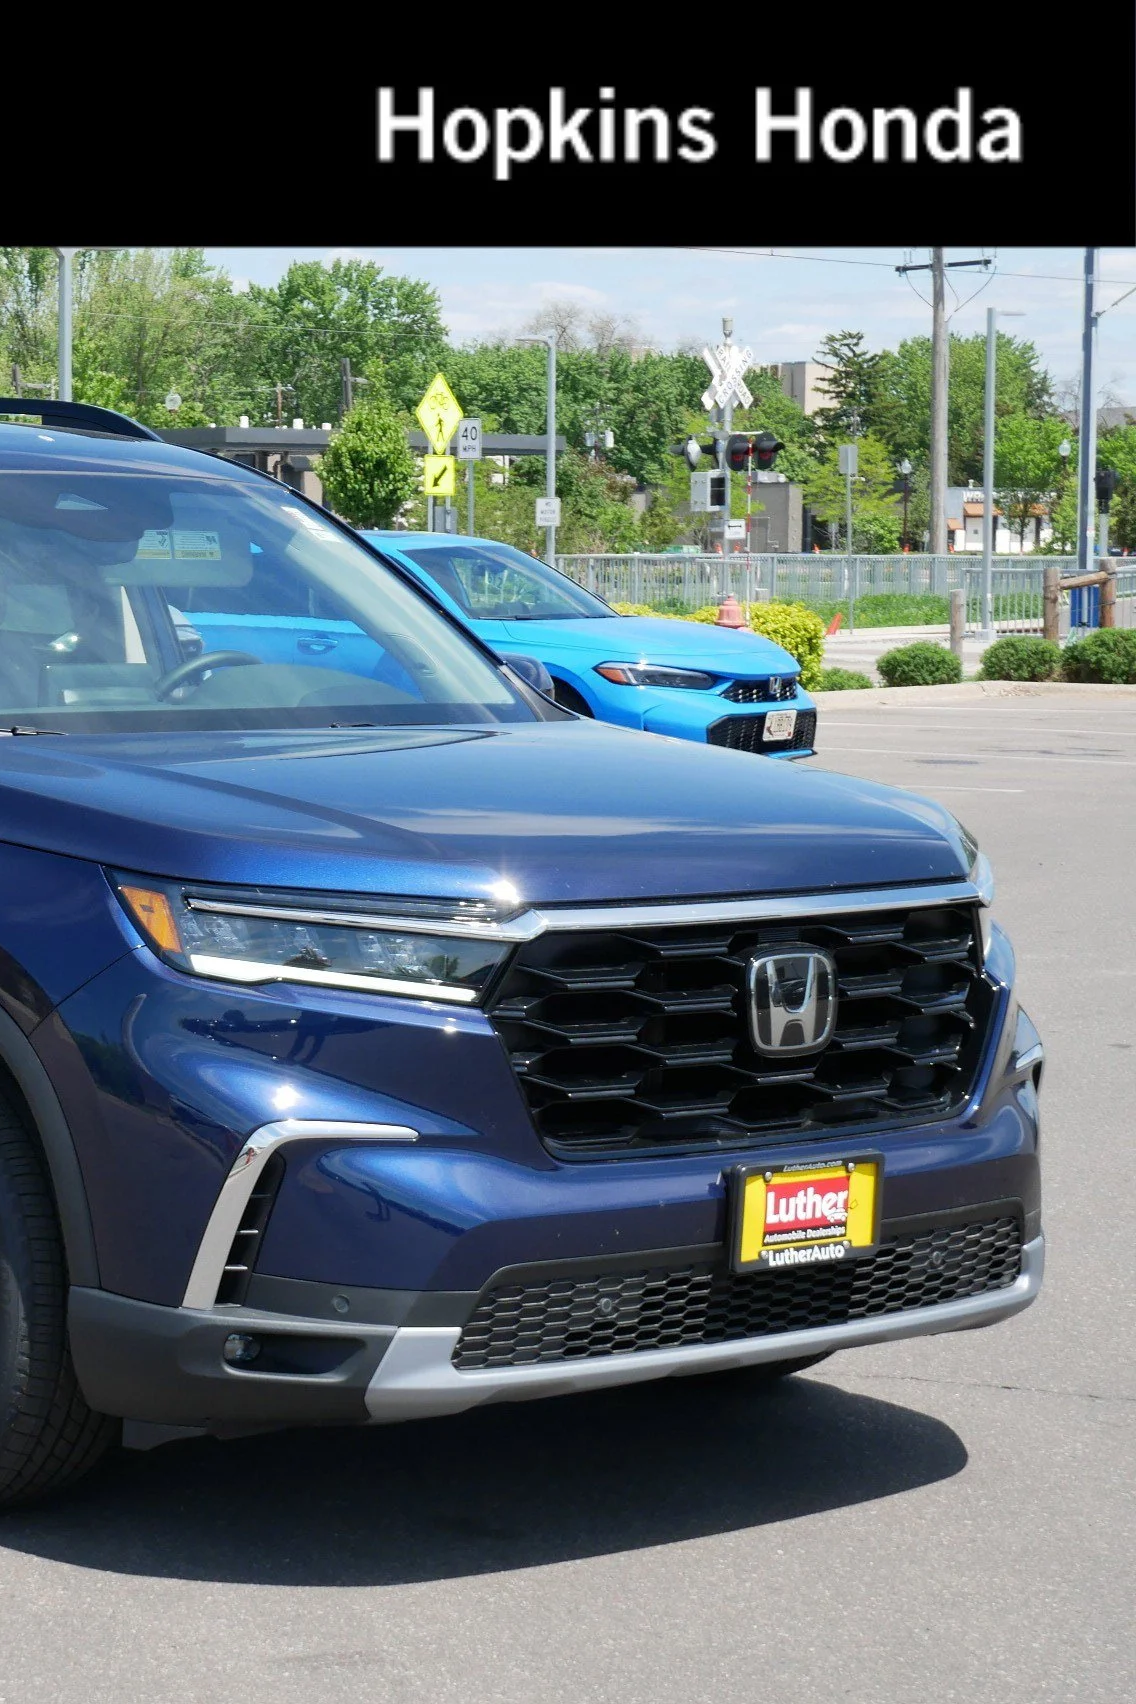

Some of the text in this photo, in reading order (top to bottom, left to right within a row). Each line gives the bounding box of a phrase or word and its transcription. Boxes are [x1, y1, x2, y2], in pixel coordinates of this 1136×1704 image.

[461, 426, 478, 441] 40
[782, 1160, 843, 1172] LutherAuto.com
[766, 1187, 849, 1224] Luther
[763, 1226, 846, 1244] Automobile Dealerships
[768, 1243, 845, 1267] LutherAuto
